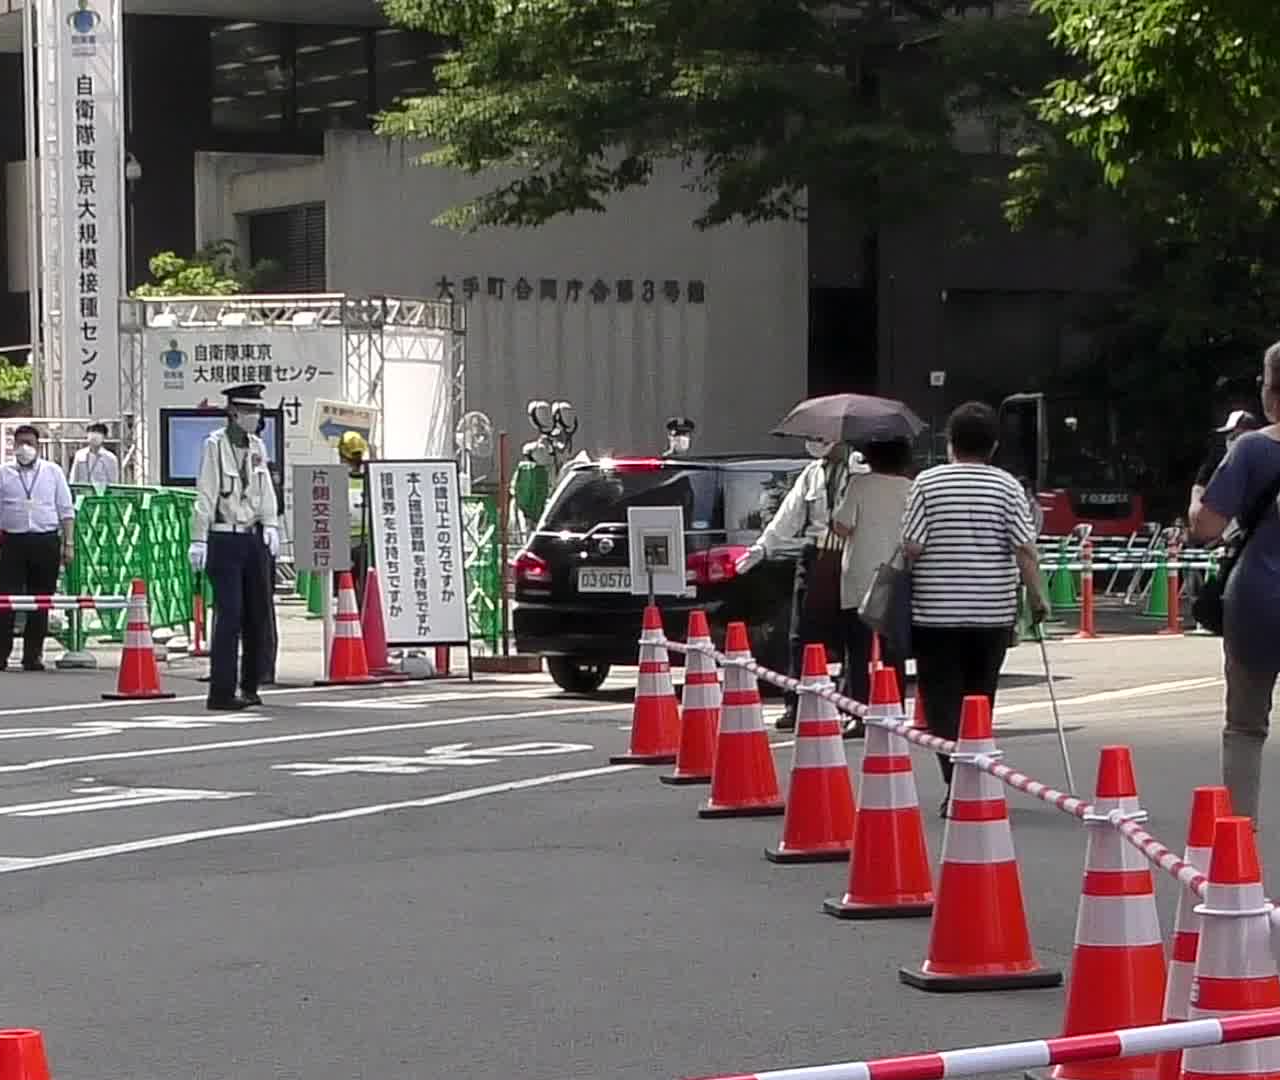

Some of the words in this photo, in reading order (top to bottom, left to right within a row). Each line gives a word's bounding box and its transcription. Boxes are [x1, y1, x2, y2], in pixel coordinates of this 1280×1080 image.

[76, 74, 98, 415] 自衛隊東京大規模接種センター
[193, 365, 335, 383] 大規模接種センター
[194, 344, 273, 362] 自衛隊東京
[312, 470, 331, 567] 片側交互通行
[380, 472, 403, 618] 接種券をお持ちですか
[406, 472, 431, 637] 本人確認書類をお持ちですか
[432, 472, 456, 603] 65歳以上の方ですか
